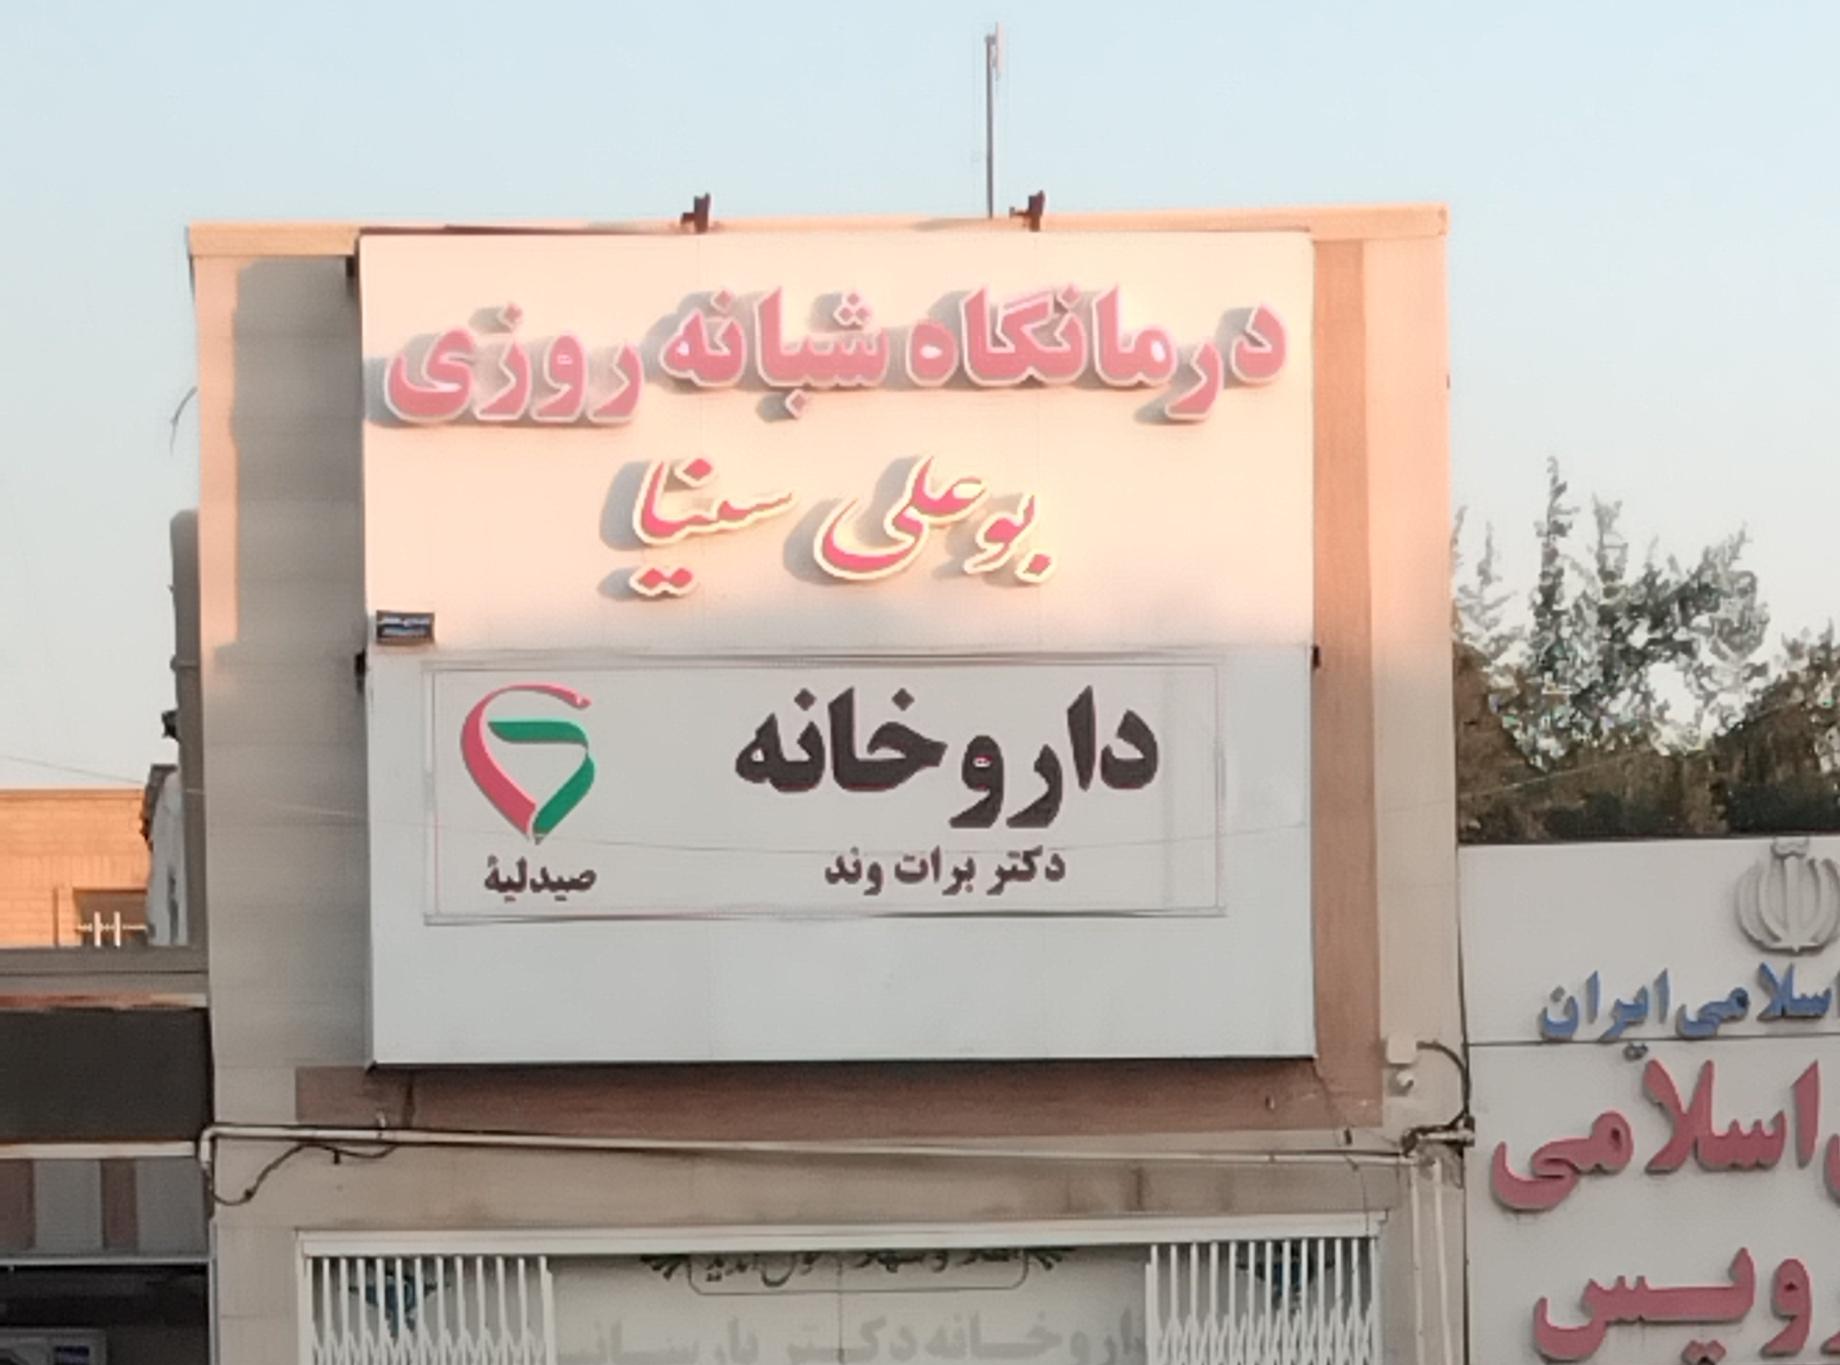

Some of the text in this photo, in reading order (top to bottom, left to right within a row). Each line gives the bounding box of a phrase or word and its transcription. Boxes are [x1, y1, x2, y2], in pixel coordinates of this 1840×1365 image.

[384, 285, 1288, 422] درمانگاه شبانه روزی
[628, 455, 795, 597] سینا
[734, 684, 1158, 829] داروخانه
[985, 845, 1066, 896] دکتر
[1539, 963, 1840, 1043] سلامی ایران
[1491, 1059, 1820, 1212] اسلامی
